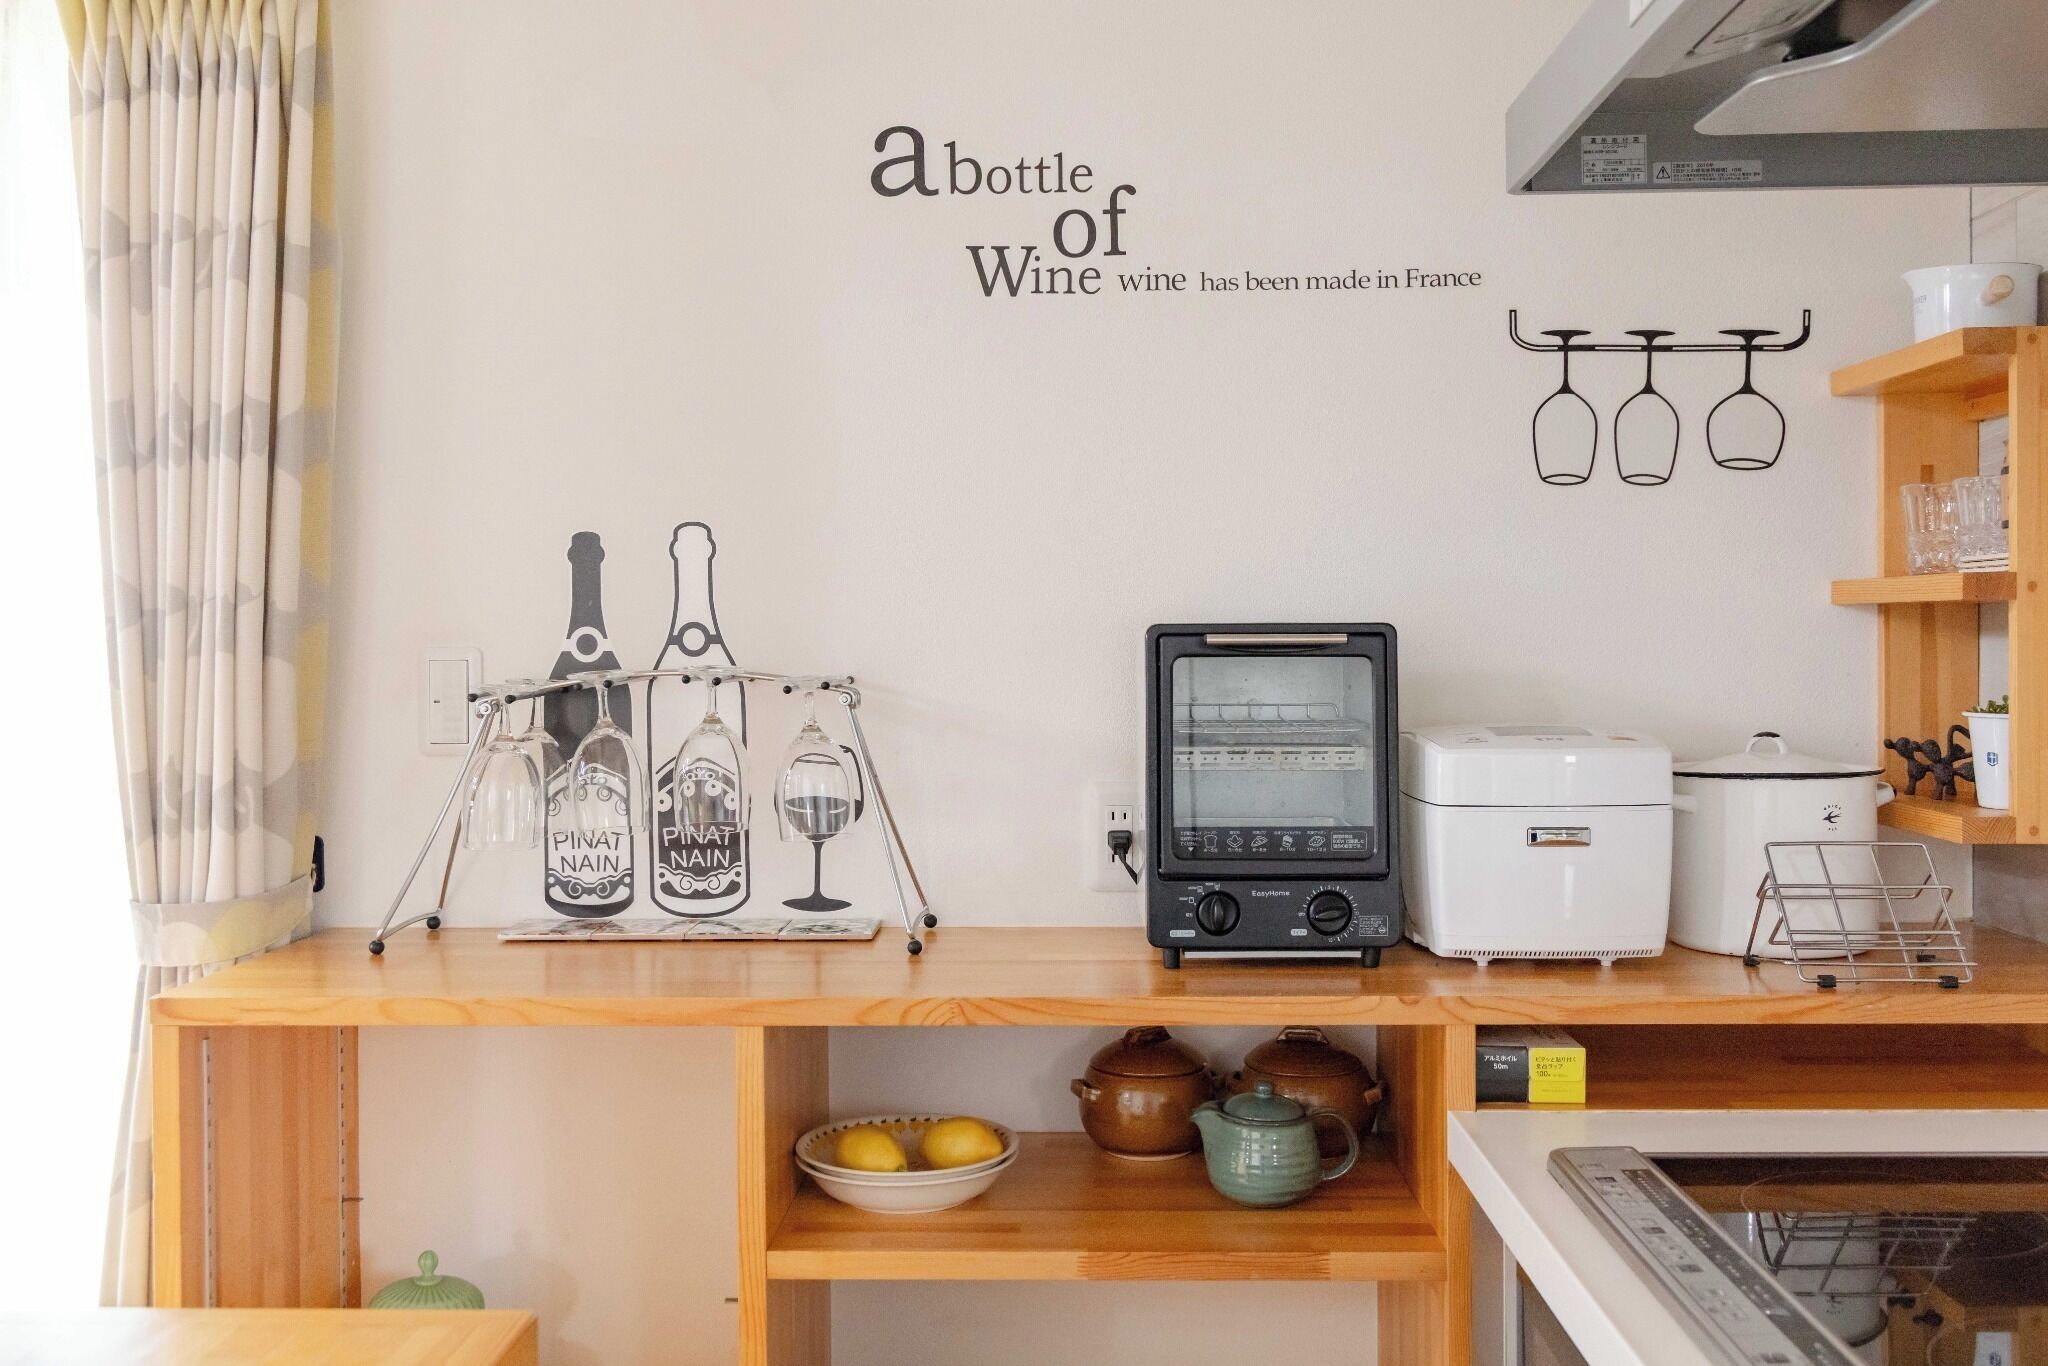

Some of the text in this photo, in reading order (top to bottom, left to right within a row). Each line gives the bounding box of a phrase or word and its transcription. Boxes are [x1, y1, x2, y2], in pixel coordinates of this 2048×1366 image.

[870, 125, 1093, 198] a bottle
[1053, 184, 1137, 259] of
[965, 245, 1482, 298] Wine wine has been made in France
[553, 830, 624, 851] PINAT
[662, 825, 734, 846] PINAT
[560, 854, 620, 874] NAIN
[670, 849, 730, 869] NAIN
[1251, 890, 1290, 899] EasyHome
[1483, 1054, 1518, 1062] アルミホイル
